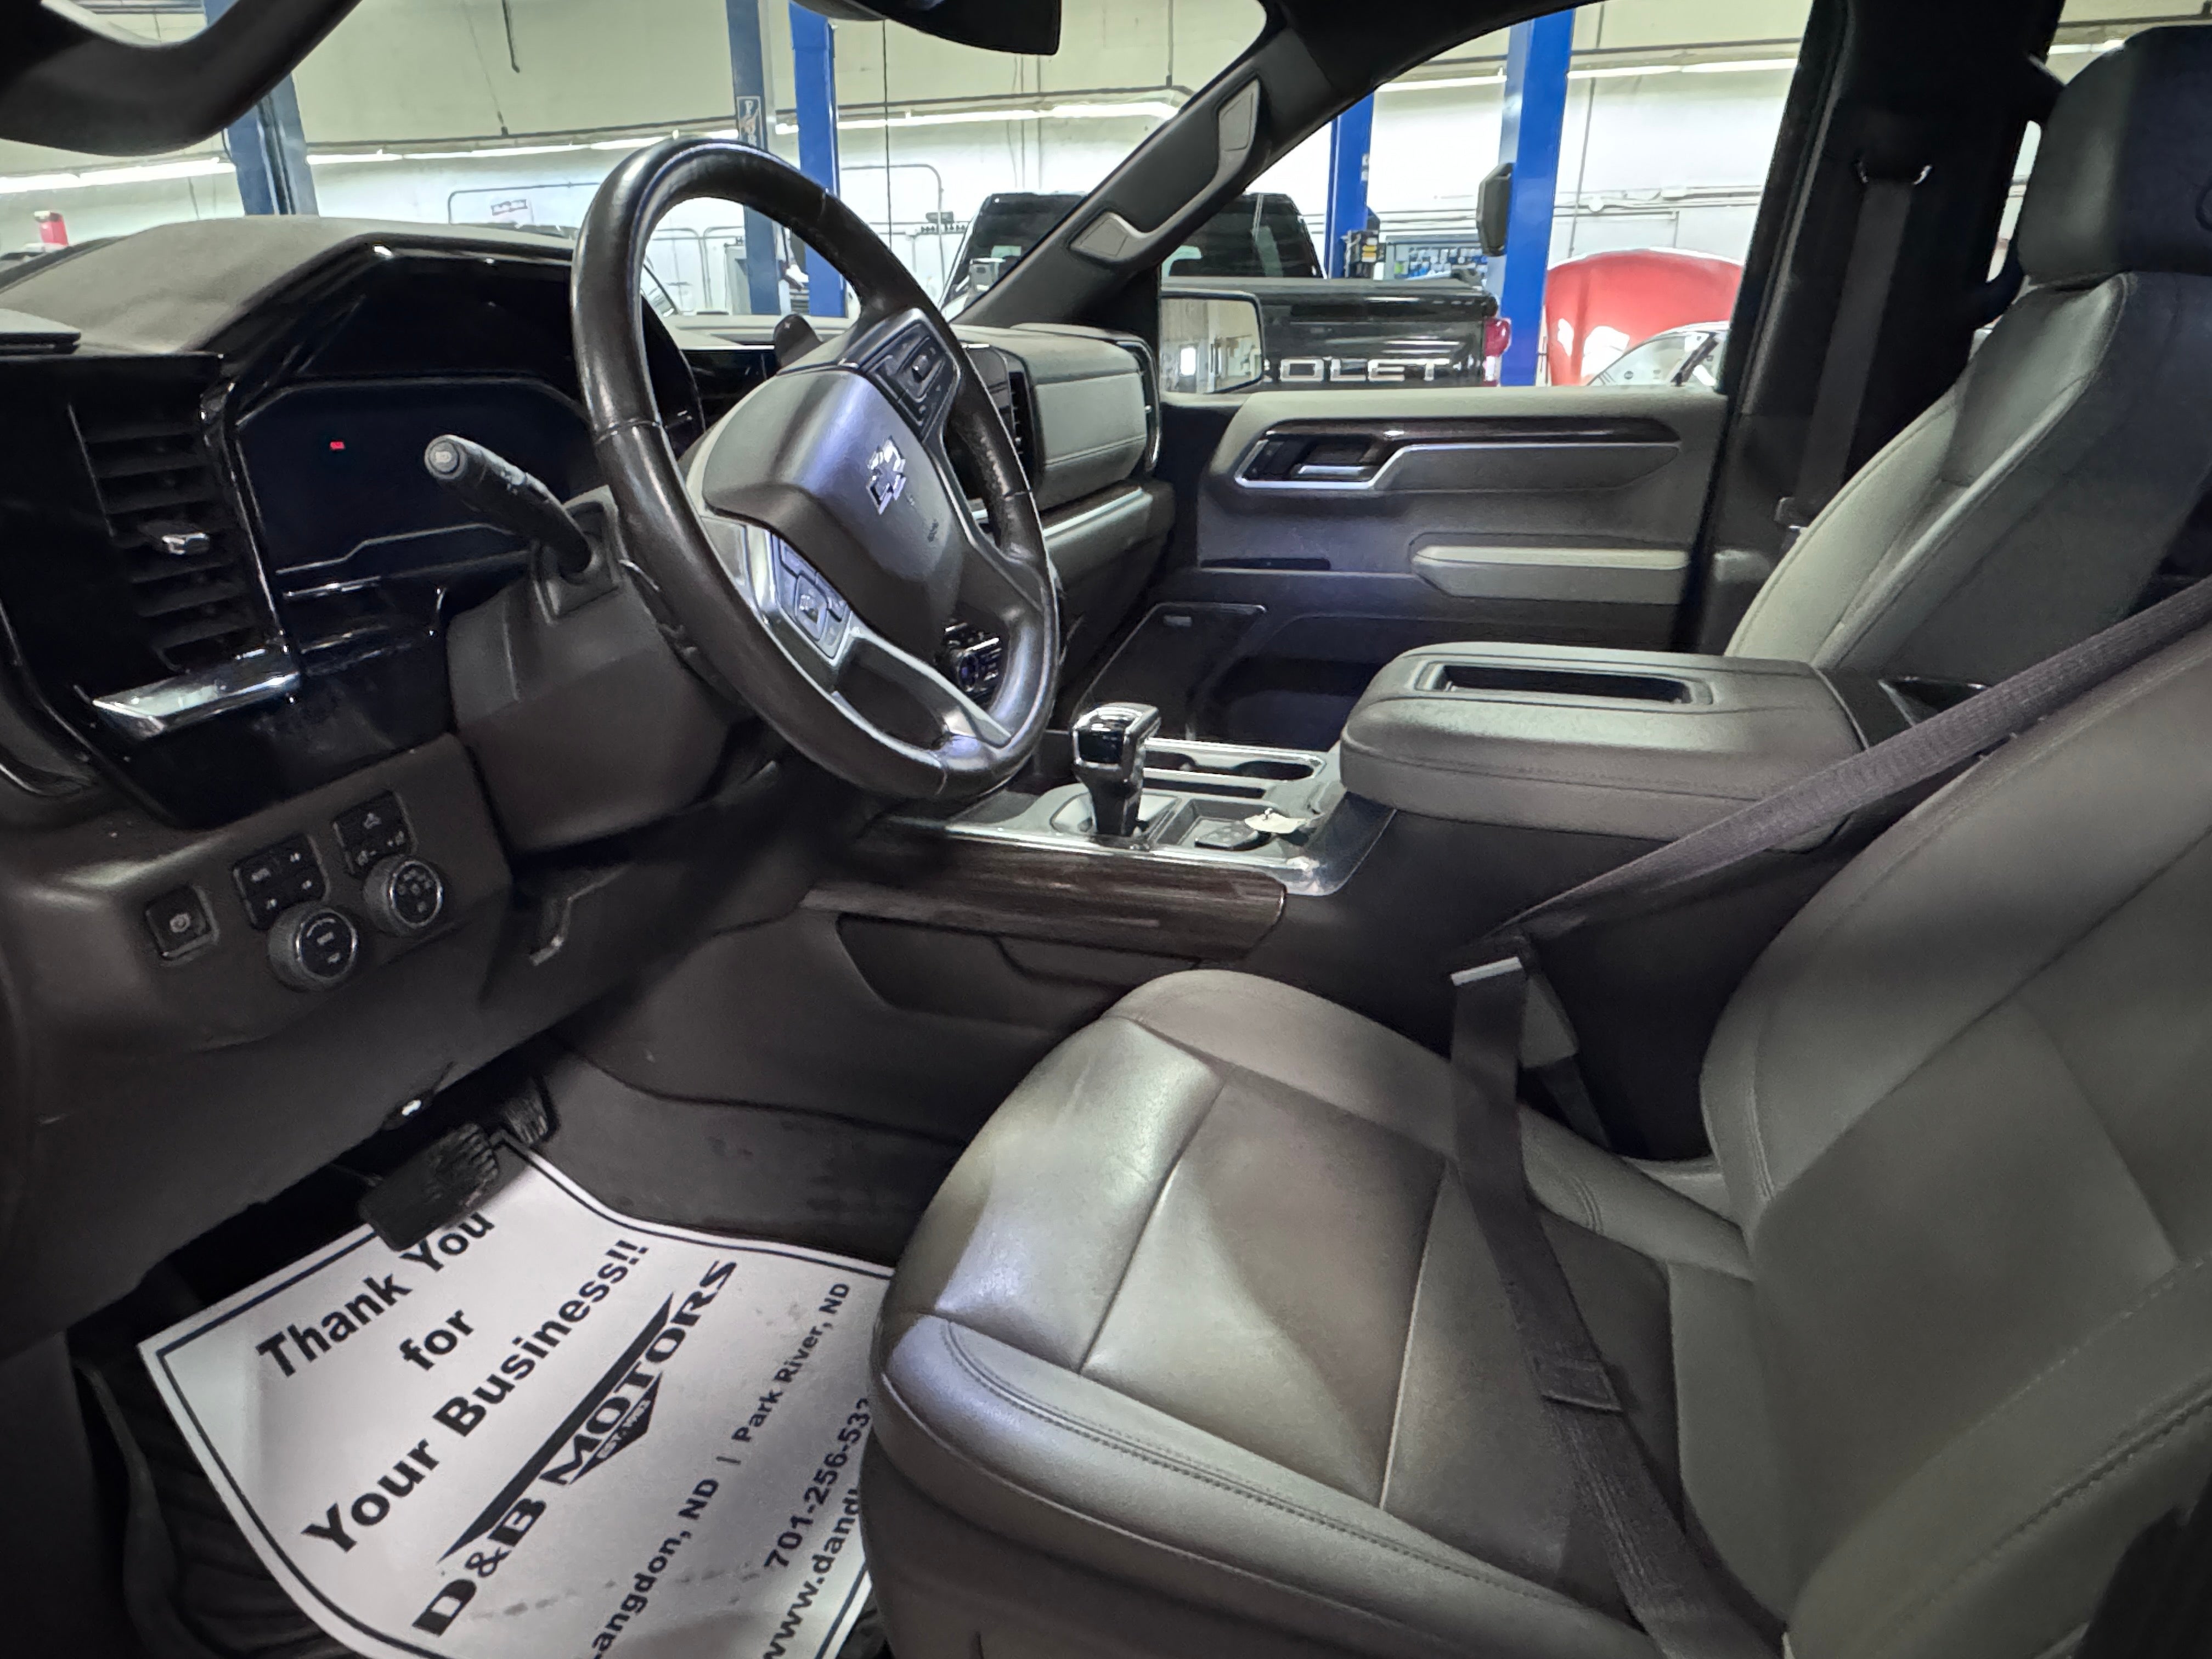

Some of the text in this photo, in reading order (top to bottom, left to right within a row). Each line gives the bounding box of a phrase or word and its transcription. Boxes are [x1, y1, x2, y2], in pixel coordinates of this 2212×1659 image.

[255, 1211, 495, 1377] Thank You
[301, 1239, 648, 1553] Your Business!!
[399, 1309, 474, 1371] for
[413, 1260, 737, 1637] D&B MOTORS
[592, 1531, 692, 1659] angdon,
[678, 1479, 720, 1521] ND
[731, 1389, 783, 1442] Park
[772, 1321, 834, 1383] River,
[819, 1283, 850, 1314] ND
